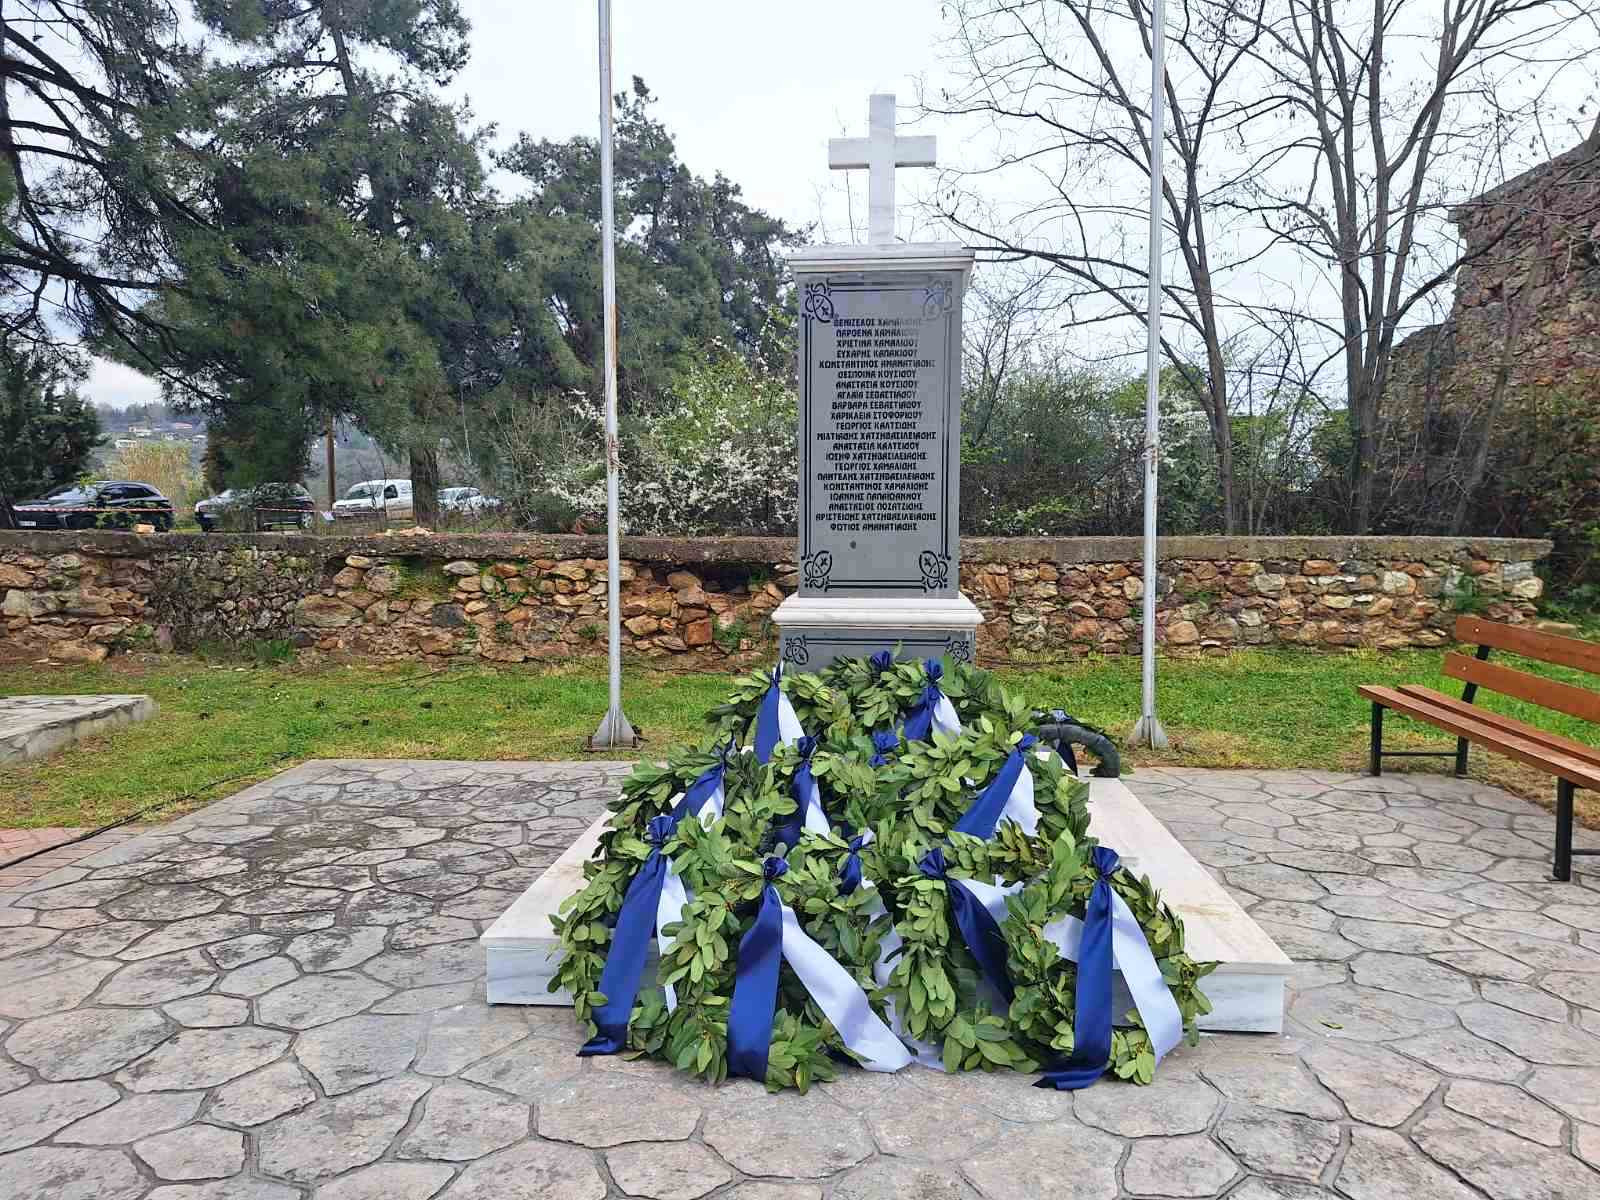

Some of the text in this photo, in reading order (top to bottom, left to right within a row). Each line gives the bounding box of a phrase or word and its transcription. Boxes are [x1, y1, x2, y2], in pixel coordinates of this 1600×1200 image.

[836, 380, 878, 390] ΑΝΑΣΤΑΣΙΑ
[831, 400, 868, 410] ΒΑΡΒΑΡΑ
[836, 421, 872, 430] ΓΕΩΡΓΙΟΣ
[834, 462, 872, 472] ΓΕΩΡΓΙΟΣ
[823, 482, 882, 491] ΚΩΝΣΤΑΝΤΙΝΟΣ
[828, 502, 875, 511] ΑΝΑΣΤΑΣΙΟΣ
[830, 523, 860, 532] ΦΩΤΙΟΣ
